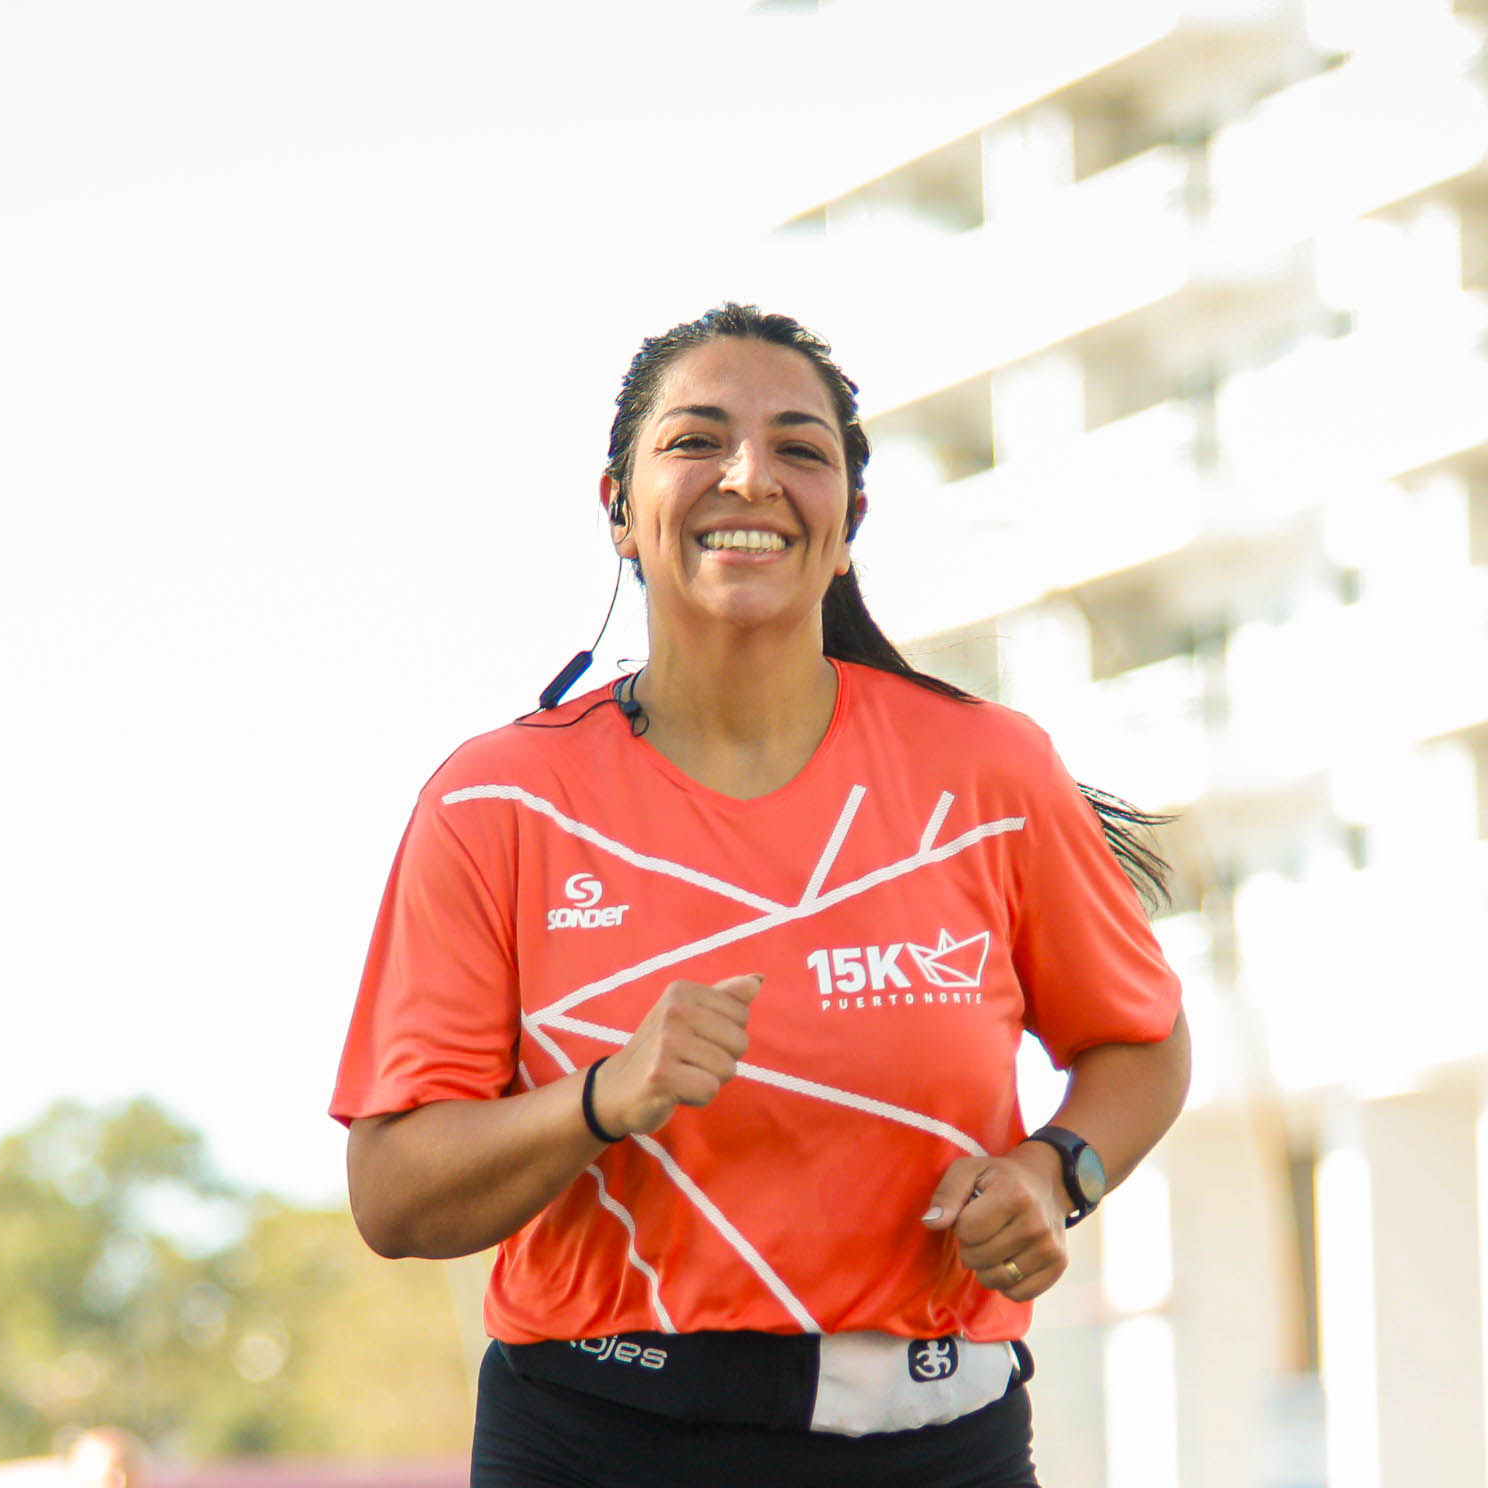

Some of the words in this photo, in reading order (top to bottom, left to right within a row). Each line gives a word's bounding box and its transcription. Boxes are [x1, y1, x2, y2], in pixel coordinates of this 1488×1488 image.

[806, 943, 912, 995] 15K
[821, 993, 915, 1011] PUERTO
[924, 992, 983, 1005] NORTE
[570, 1334, 668, 1369] ojes
